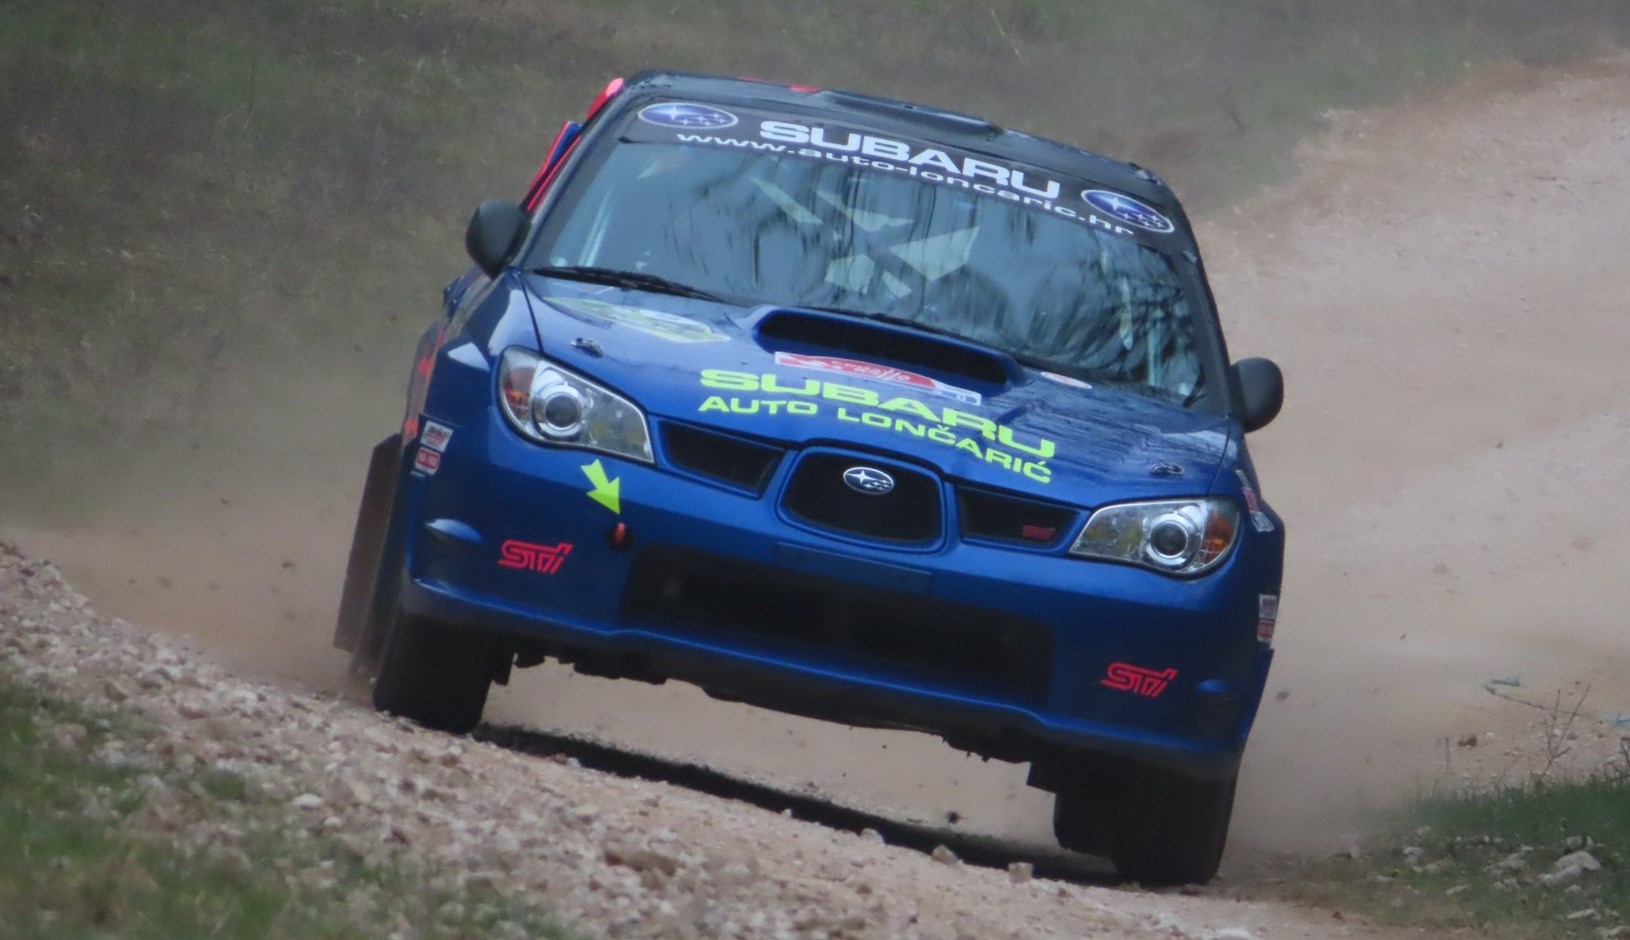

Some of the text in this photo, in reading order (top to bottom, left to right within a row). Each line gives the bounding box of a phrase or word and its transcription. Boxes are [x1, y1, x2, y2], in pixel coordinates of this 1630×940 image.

[677, 132, 1134, 235] www.auto-loncaric.hr
[760, 120, 1060, 200] SUBARU
[698, 395, 1052, 484] AUTO LONČARIĆ
[700, 368, 1055, 458] SUBARU
